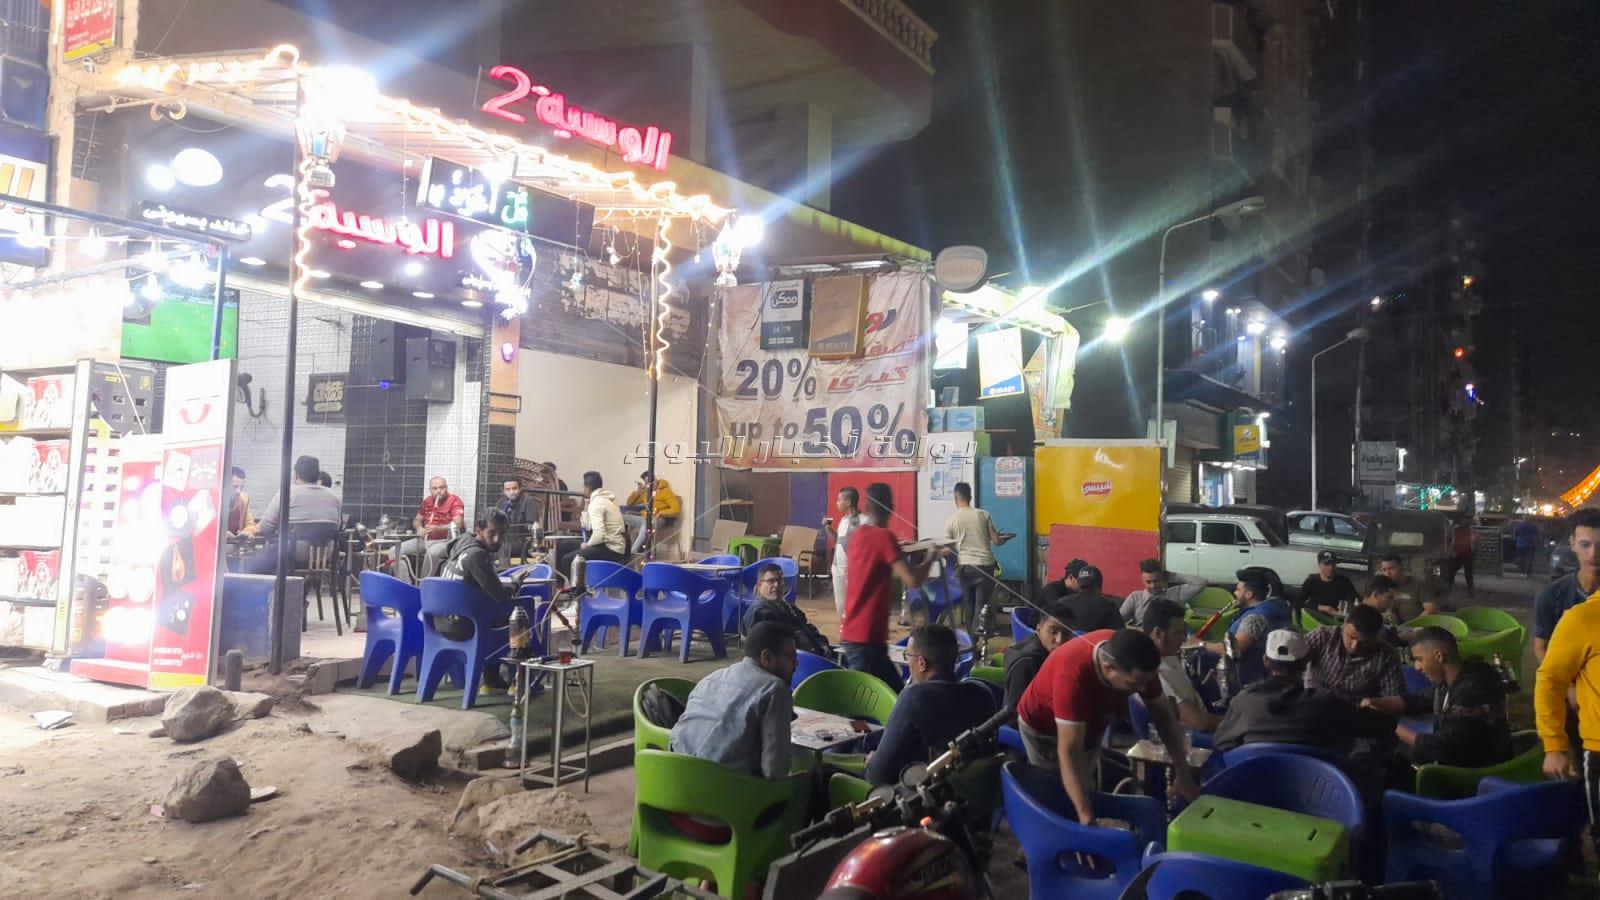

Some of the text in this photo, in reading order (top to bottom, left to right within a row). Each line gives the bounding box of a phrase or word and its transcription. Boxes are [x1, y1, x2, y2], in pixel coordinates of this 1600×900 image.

[480, 65, 672, 172] الوسية 2
[735, 357, 817, 403] 20%
[730, 401, 917, 460] up to 50%
